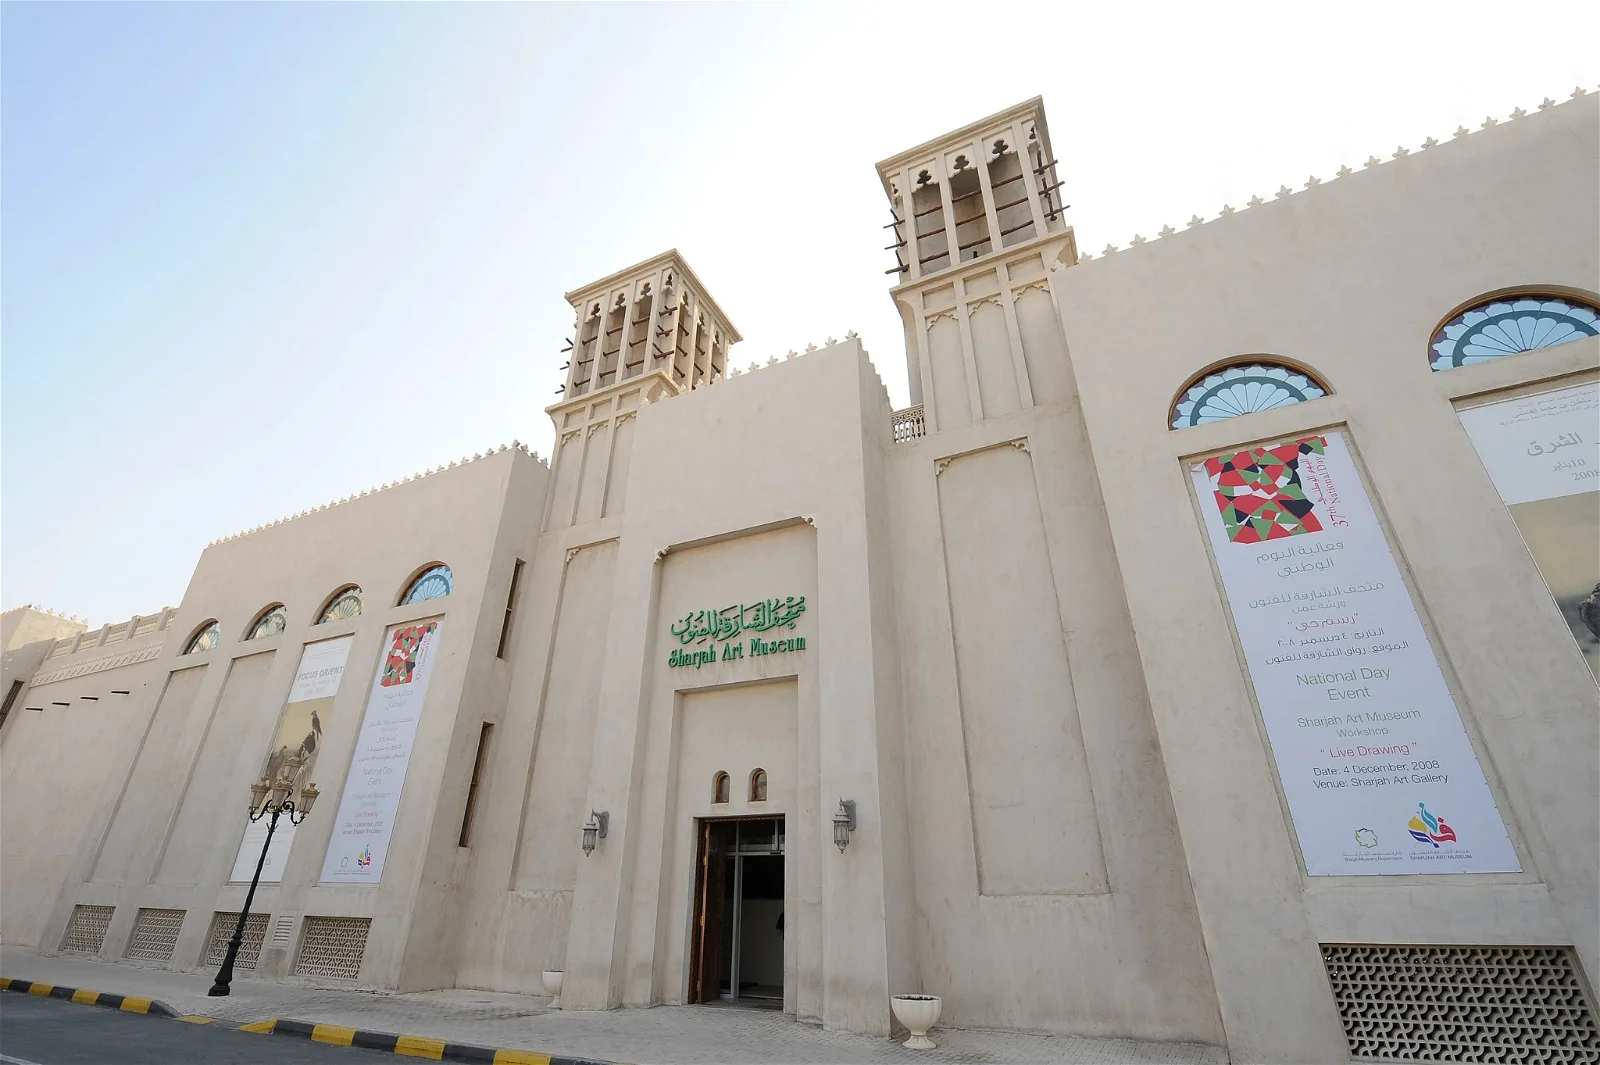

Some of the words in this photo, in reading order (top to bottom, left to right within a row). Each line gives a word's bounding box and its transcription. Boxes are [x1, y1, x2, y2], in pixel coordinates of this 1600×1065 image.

[1527, 432, 1583, 456] الشرق
[1316, 456, 1326, 473] Day
[1319, 472, 1340, 504] National
[1256, 547, 1296, 564] اليوم
[1298, 540, 1344, 556] فعالية
[1277, 558, 1334, 580] الوطني
[1294, 586, 1341, 602] الشارقة
[1344, 581, 1385, 595] متحف
[1248, 594, 1292, 610] للفنون
[668, 644, 716, 670] Sharjah
[722, 642, 744, 662] Art
[750, 636, 806, 658] Museum
[297, 670, 318, 682] FOCUS
[320, 666, 344, 677] ORIENT
[1296, 669, 1357, 686] National
[1360, 666, 1391, 681] Day
[1327, 686, 1372, 701] Event
[1297, 715, 1342, 728] Sharjah
[1346, 713, 1363, 724] Art
[1366, 708, 1422, 722] Museum
[1336, 726, 1389, 738] Workshop
[1329, 747, 1355, 758] Live
[1356, 743, 1410, 757] Drawing
[1313, 766, 1341, 776] Date:
[1344, 766, 1350, 774] 4
[1412, 760, 1440, 770] 2008
[1313, 779, 1348, 789] Venue:
[1350, 776, 1391, 788] Sharjah
[1393, 775, 1409, 784] Art
[1411, 773, 1448, 784] Gallery
